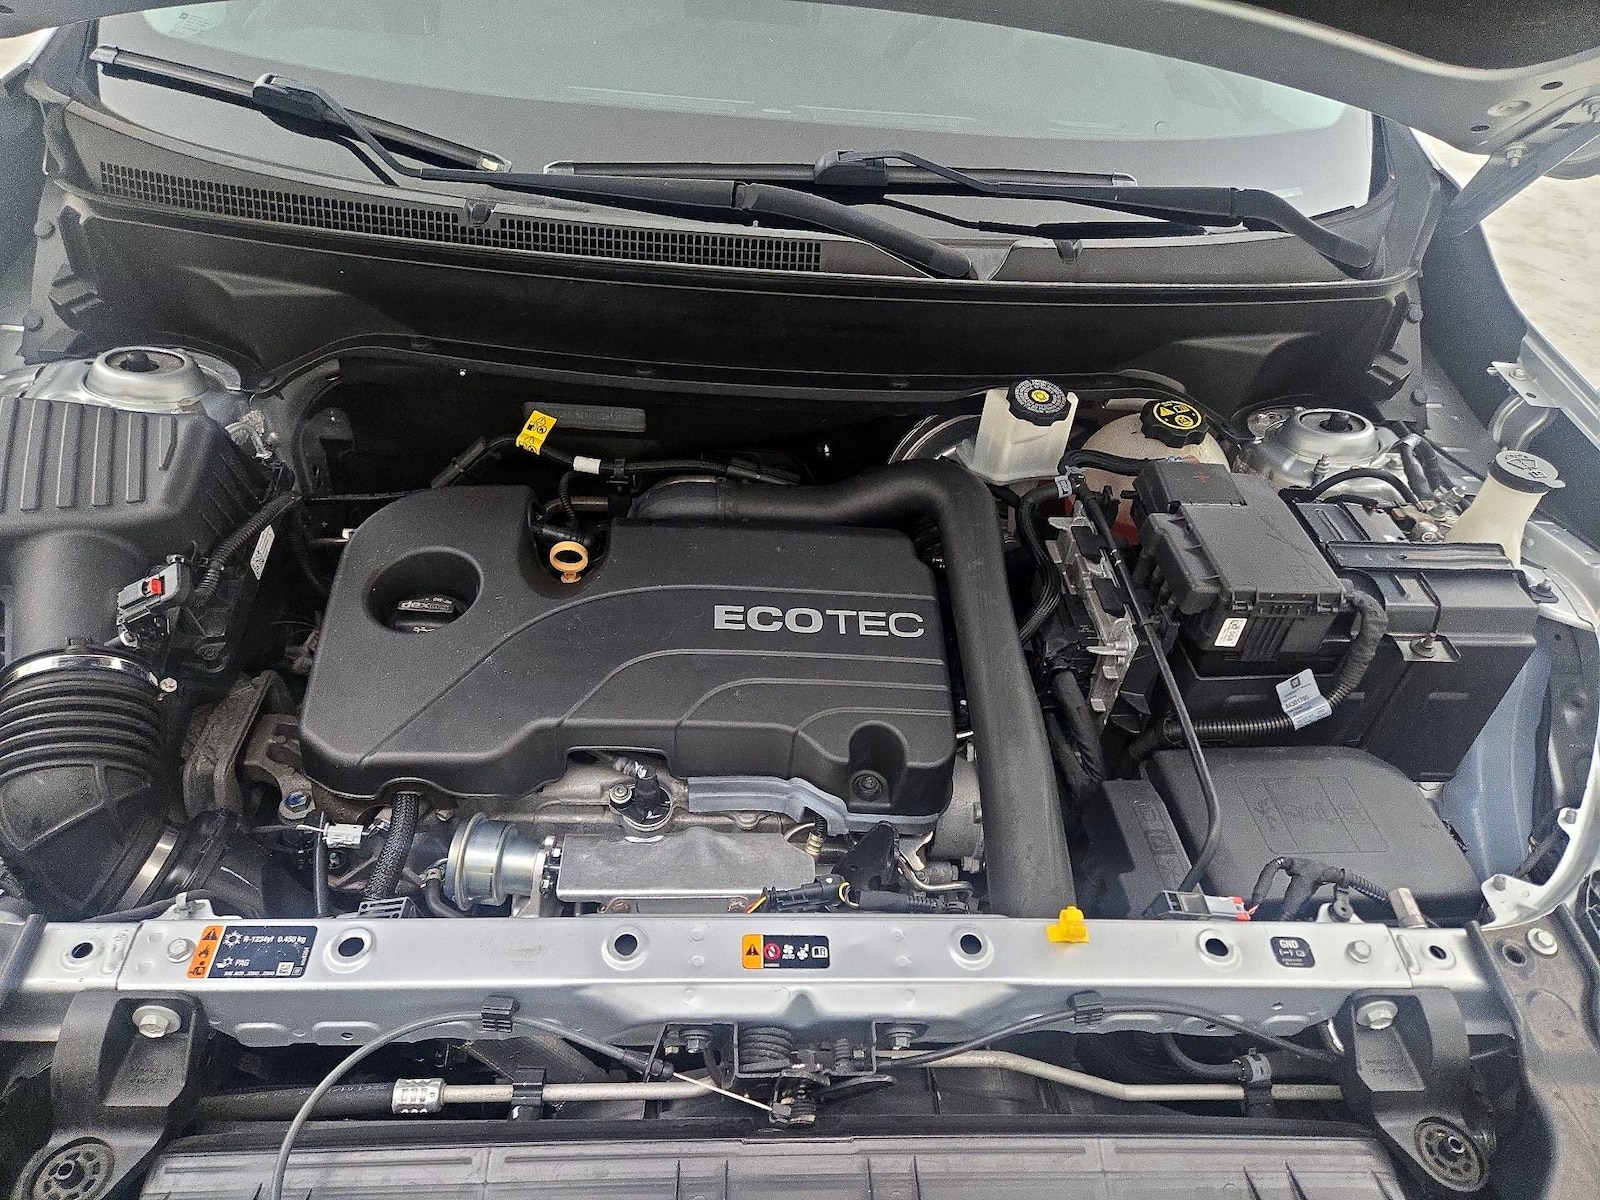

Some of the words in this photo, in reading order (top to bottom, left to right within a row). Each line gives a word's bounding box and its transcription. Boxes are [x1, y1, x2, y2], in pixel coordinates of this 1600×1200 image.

[714, 605, 925, 638] ECOTEC
[243, 935, 274, 944] R-1234yf
[1279, 939, 1299, 949] GND
[234, 959, 250, 967] PAG
